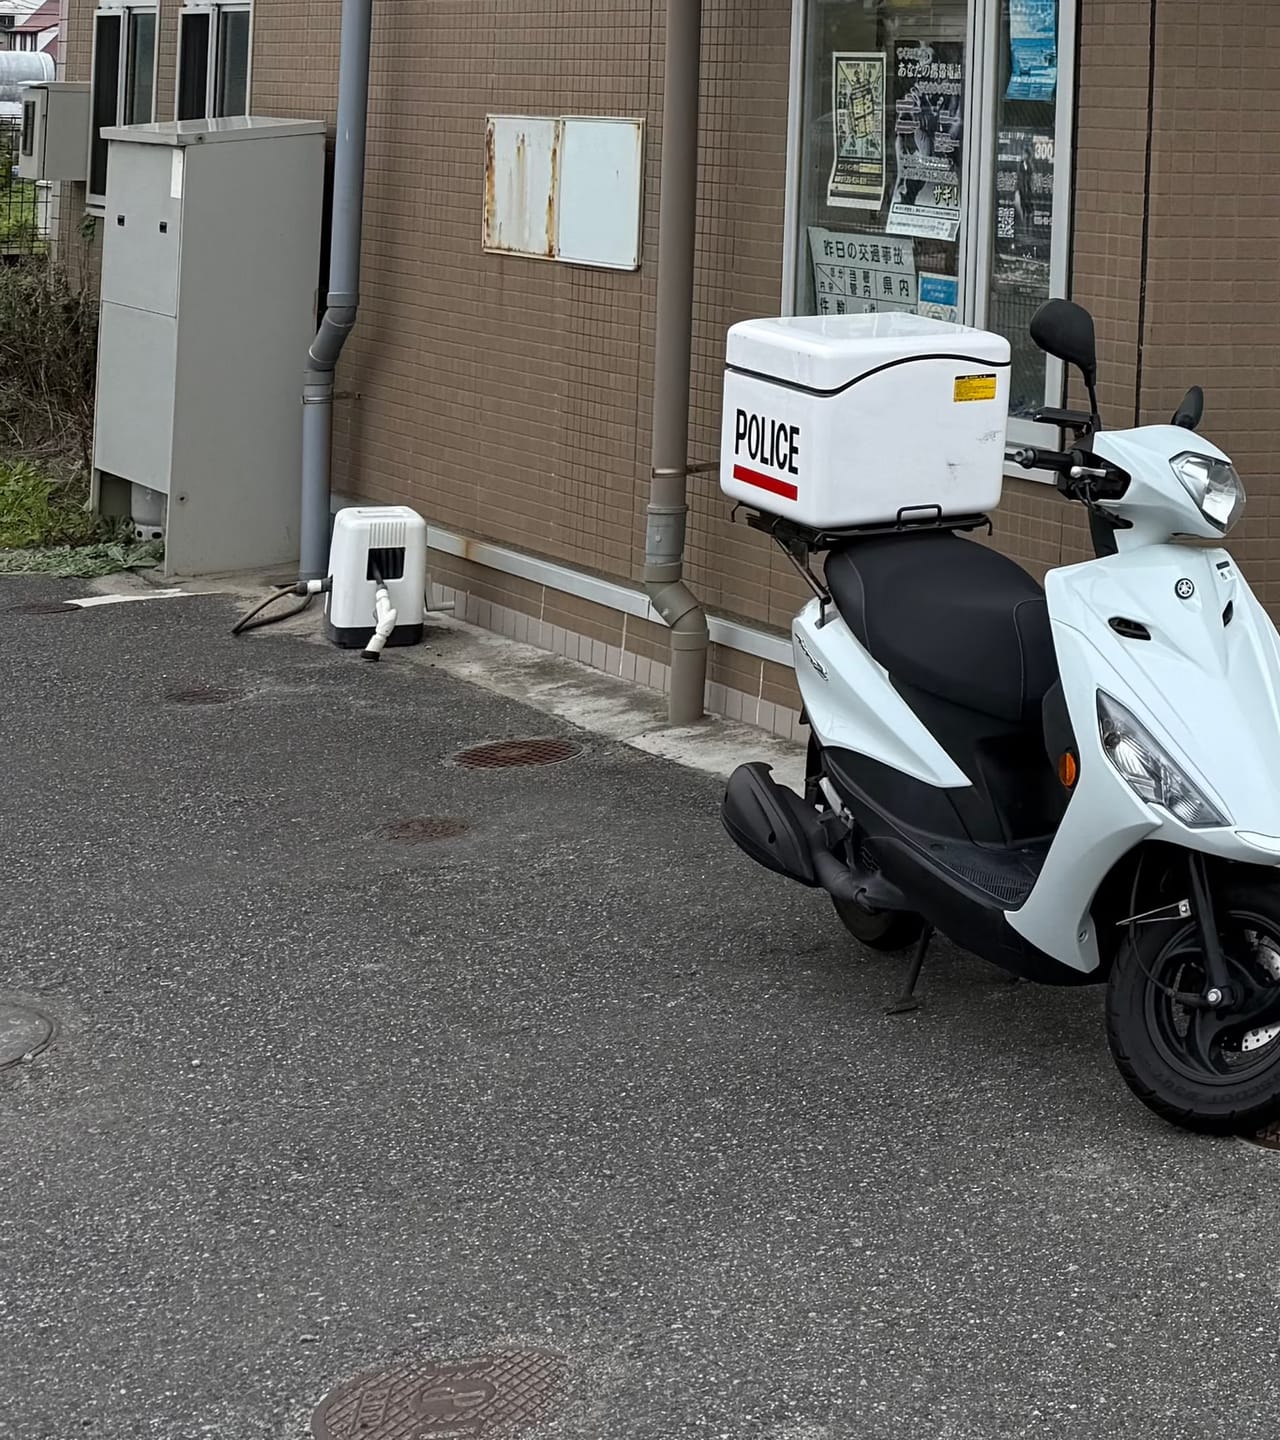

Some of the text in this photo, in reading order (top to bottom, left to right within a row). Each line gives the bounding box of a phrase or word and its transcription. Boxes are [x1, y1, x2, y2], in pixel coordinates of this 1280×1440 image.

[824, 240, 904, 265] 昨日の交通事故
[882, 275, 910, 298] 県内
[734, 407, 800, 475] POLICE
